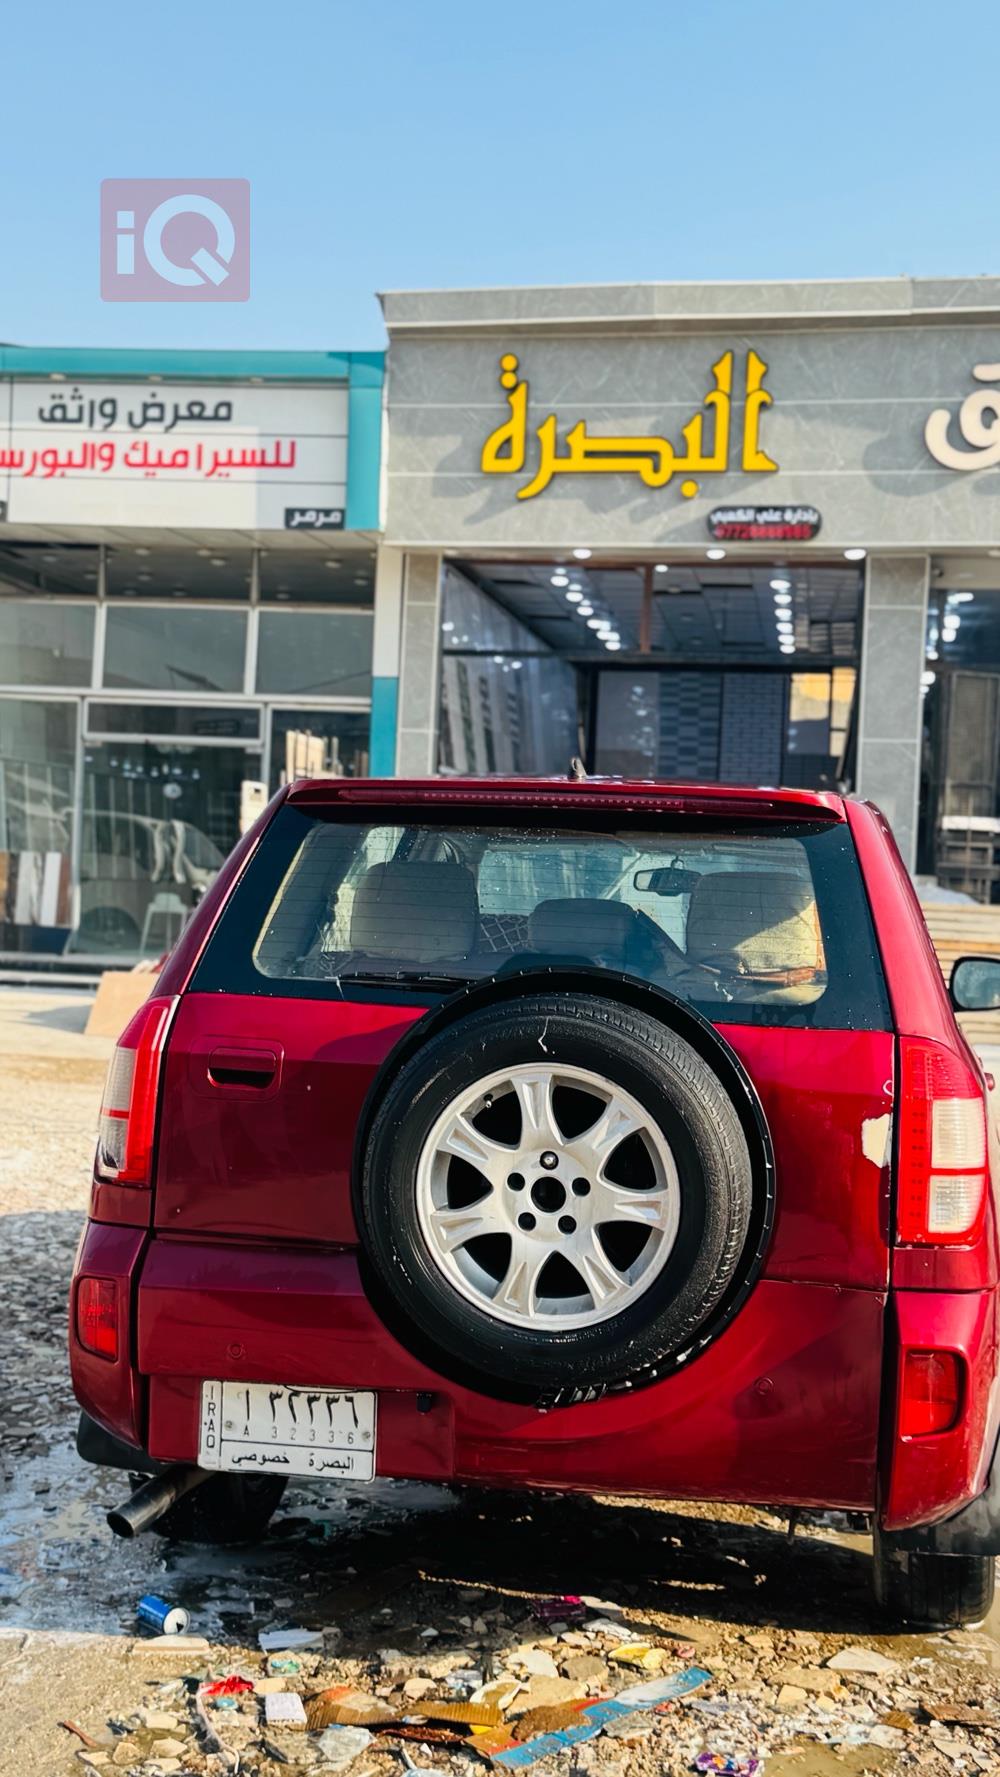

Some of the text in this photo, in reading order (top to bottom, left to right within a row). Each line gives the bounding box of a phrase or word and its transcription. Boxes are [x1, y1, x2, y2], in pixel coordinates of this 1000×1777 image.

[39, 387, 232, 433] معرض واثق
[481, 350, 779, 500] البصرة
[0, 440, 296, 478] للسيراميك والبورس
[290, 510, 341, 527] مرمر
[271, 1426, 355, 1445] 32336
[231, 1451, 355, 1475] البصرة خصوصي
